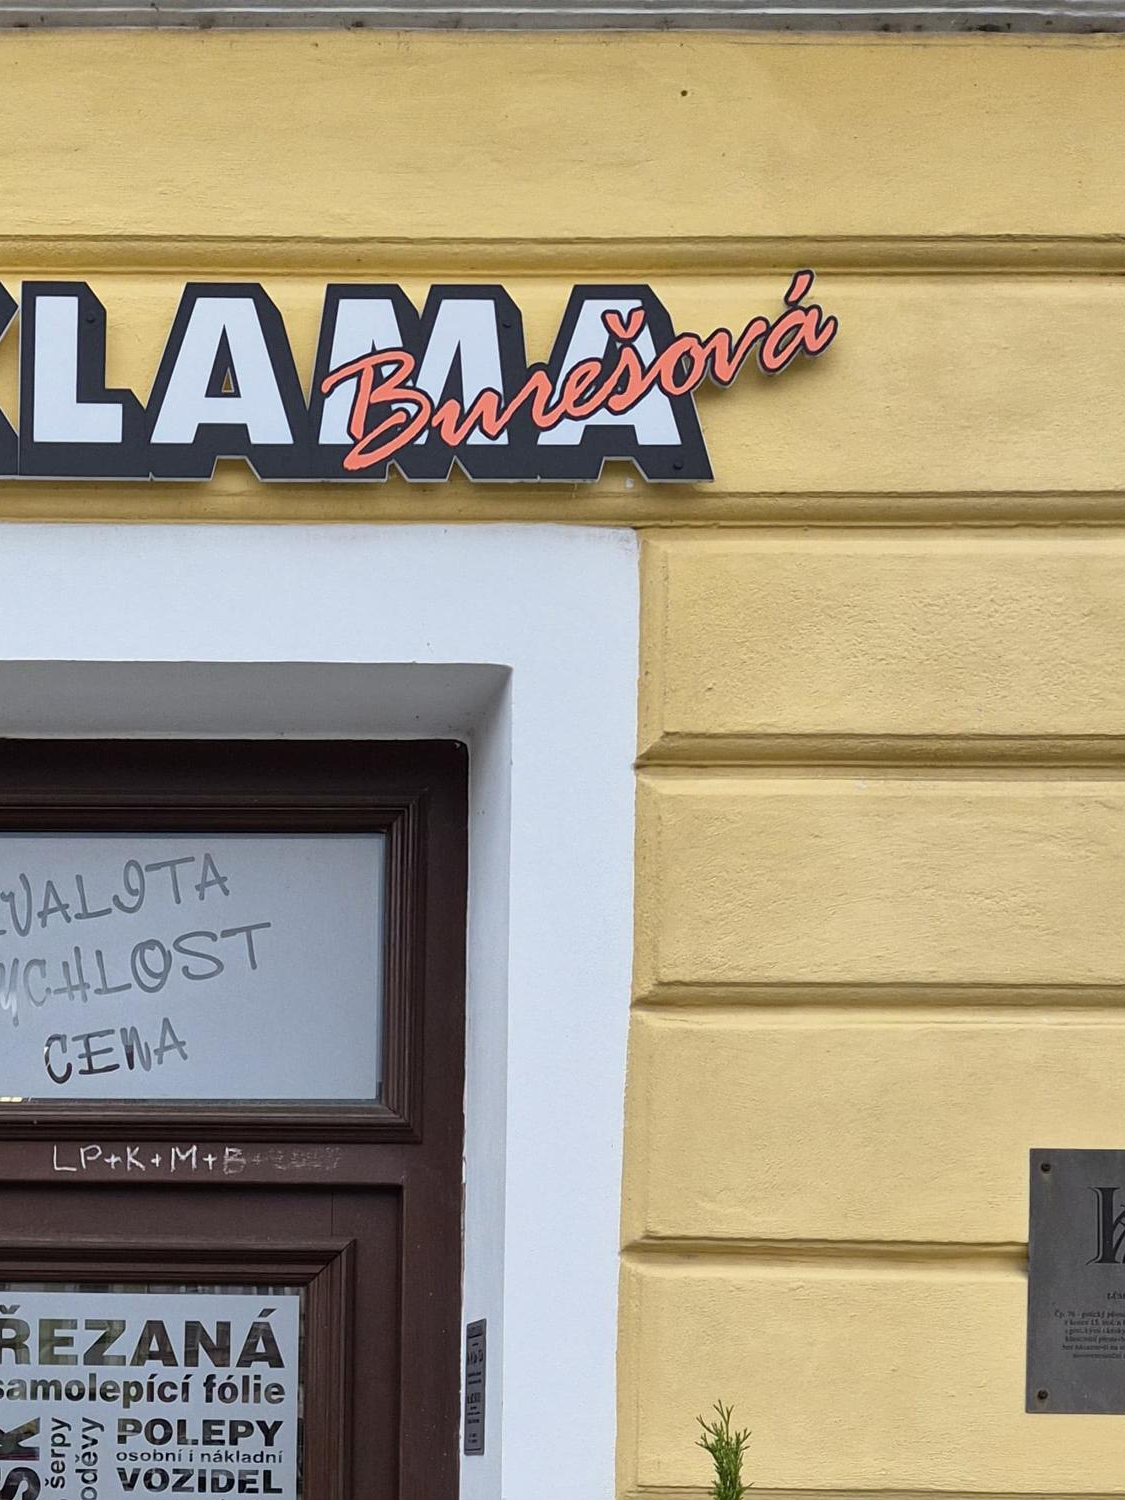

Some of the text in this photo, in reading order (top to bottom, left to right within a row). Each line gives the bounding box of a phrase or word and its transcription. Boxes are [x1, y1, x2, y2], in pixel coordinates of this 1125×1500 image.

[321, 268, 838, 473] Burešová
[44, 1017, 189, 1085] CENA
[203, 1373, 286, 1405] fólie
[117, 1418, 284, 1447] POLEPY
[44, 1417, 72, 1489] šerpy
[116, 1449, 284, 1464] osobní i nákladní
[116, 1467, 284, 1494] VOZIDEL
